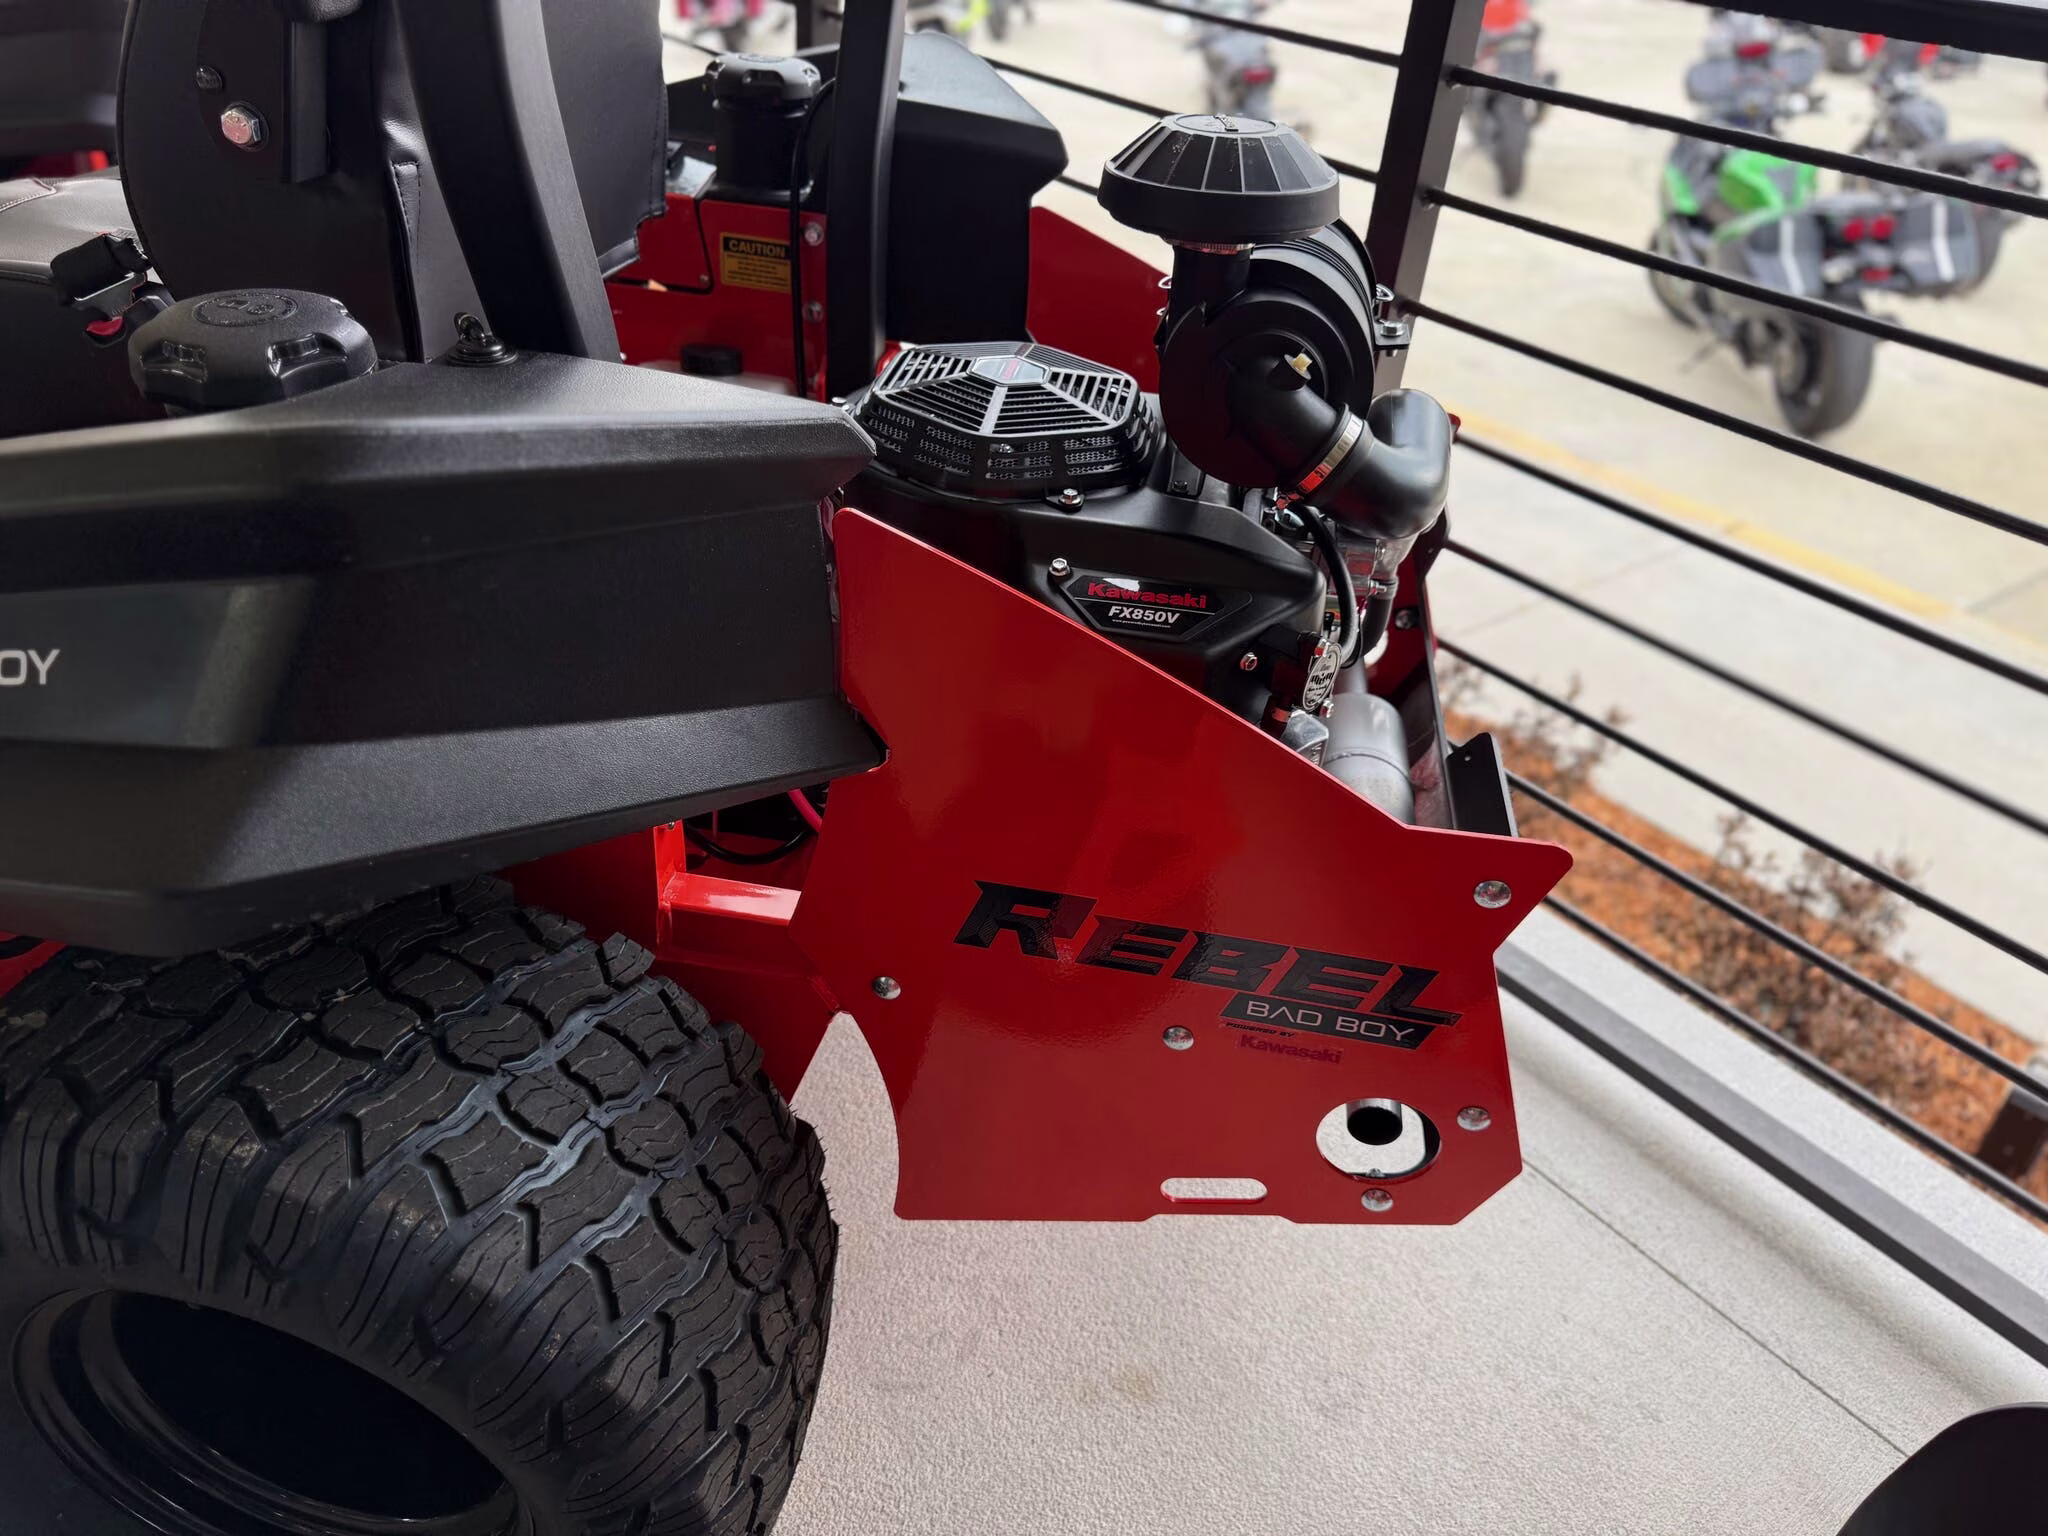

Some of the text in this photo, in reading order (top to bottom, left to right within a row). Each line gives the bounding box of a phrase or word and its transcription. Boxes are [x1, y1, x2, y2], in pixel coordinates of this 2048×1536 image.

[729, 240, 785, 257] CAUTION
[1088, 582, 1207, 609] Kawasaki
[1108, 606, 1180, 624] FX850V
[953, 880, 1464, 1028] REBEL
[1226, 1022, 1277, 1036] POWERED
[1247, 1001, 1415, 1041] BAD BOY
[1240, 1034, 1343, 1064] Kawasaki
